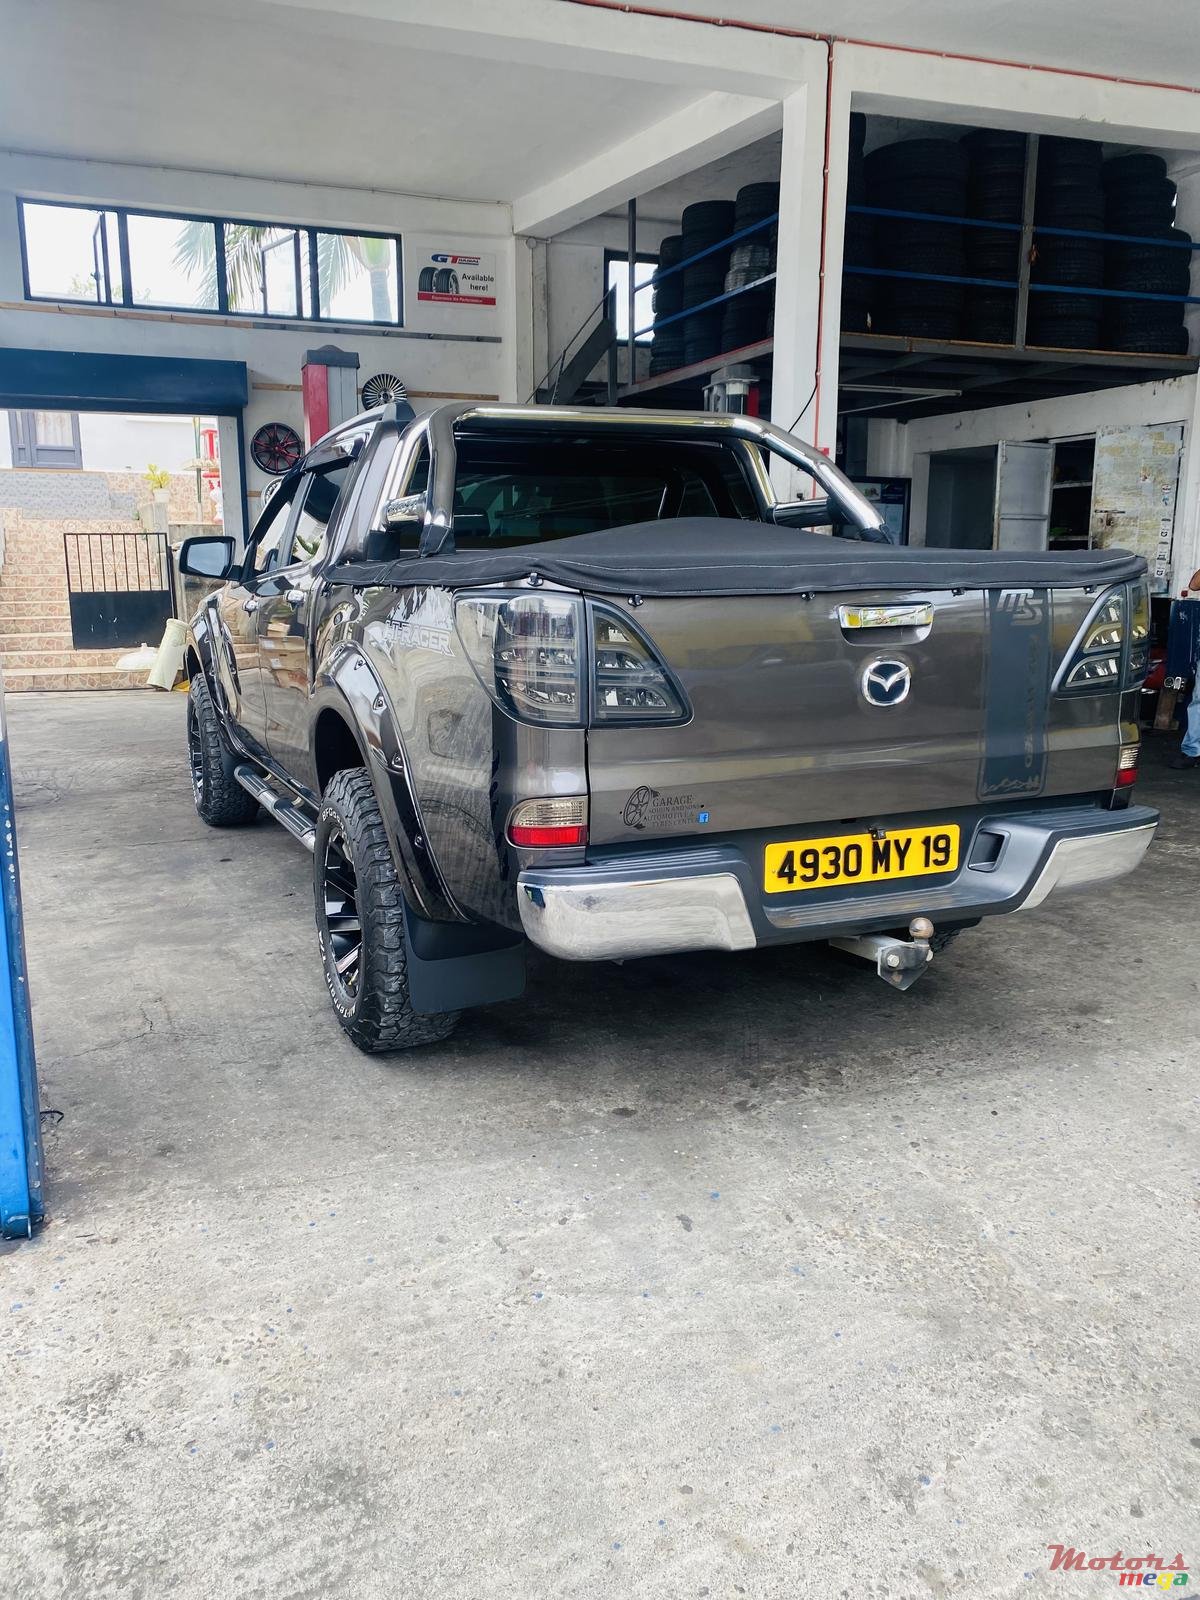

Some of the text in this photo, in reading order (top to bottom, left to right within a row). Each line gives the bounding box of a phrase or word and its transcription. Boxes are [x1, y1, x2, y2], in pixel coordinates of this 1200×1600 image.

[431, 254, 459, 264] GT
[462, 273, 494, 282] Available
[470, 283, 488, 292] here!
[652, 795, 692, 807] GARAGE
[777, 834, 951, 884] 4930 MY 19
